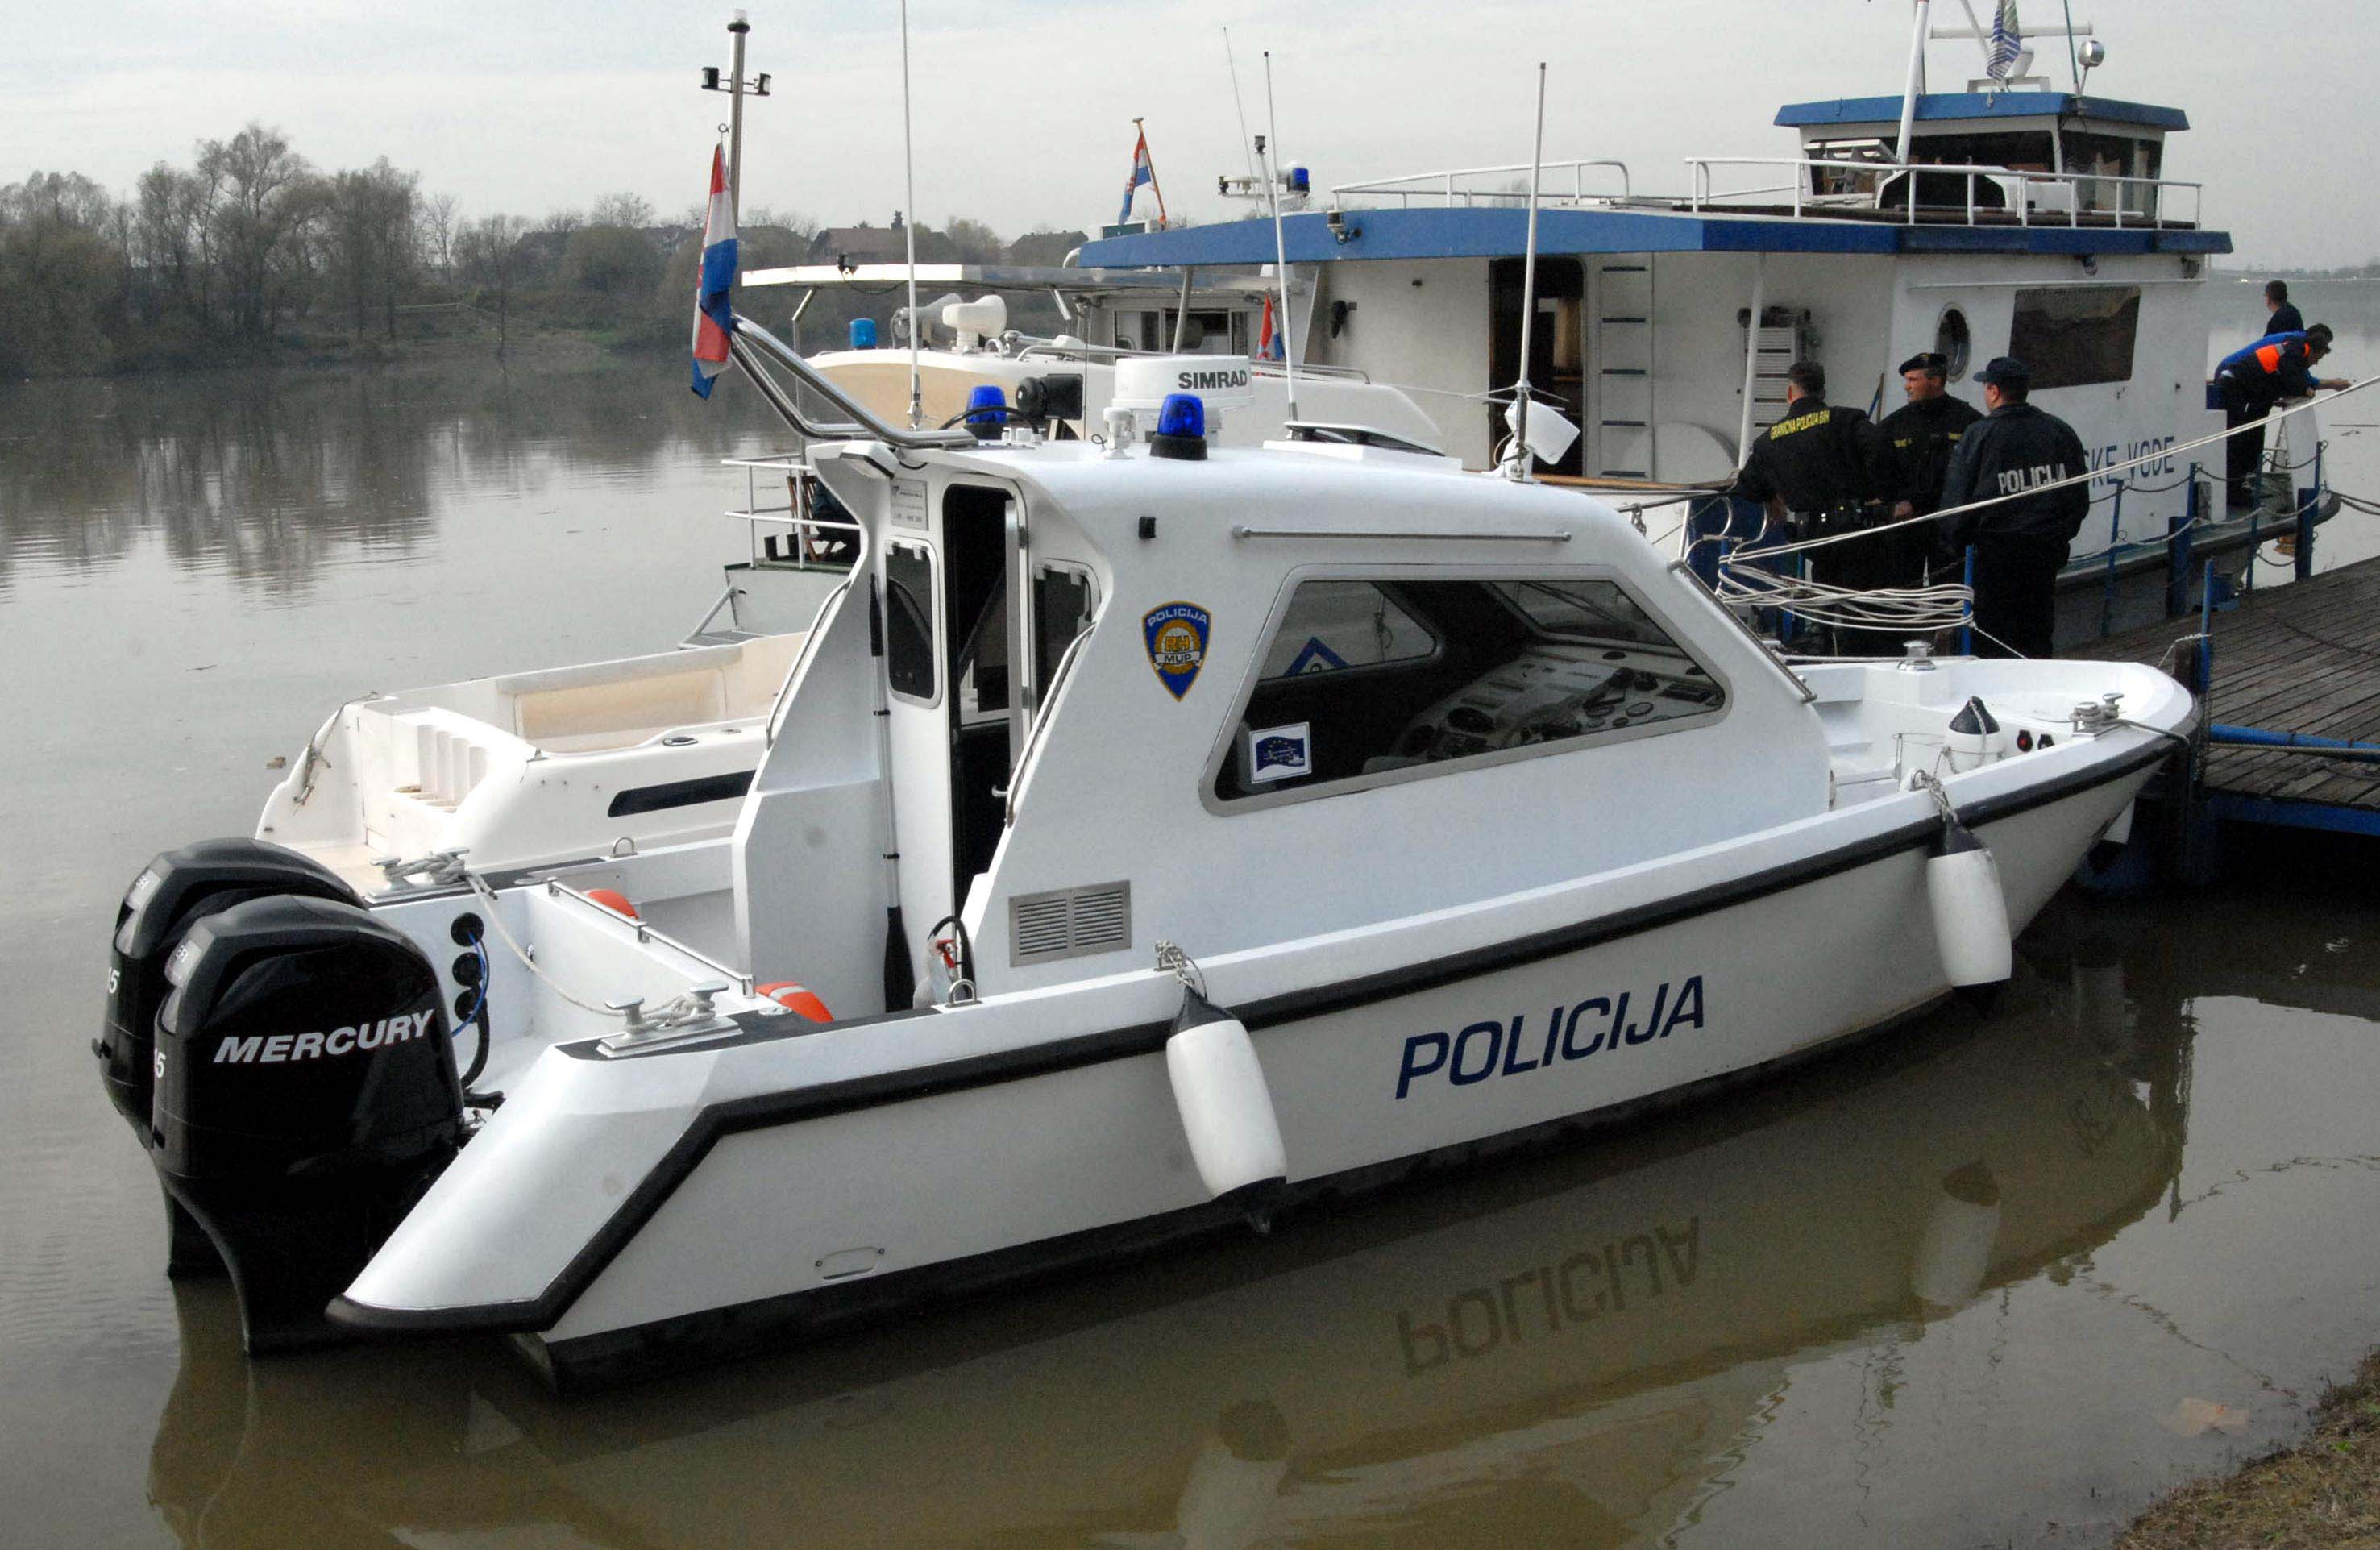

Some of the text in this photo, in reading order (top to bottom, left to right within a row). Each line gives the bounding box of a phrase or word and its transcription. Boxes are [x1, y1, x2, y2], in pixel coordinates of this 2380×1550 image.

[1178, 370, 1248, 389] SIMRAD
[2127, 436, 2174, 485] VODE
[1148, 607, 1208, 627] POLICIJA
[1165, 635, 1190, 653] RH
[1165, 654, 1192, 663] MUP
[213, 1009, 434, 1063] MERCURY
[1395, 975, 1704, 1100] POLICIJA
